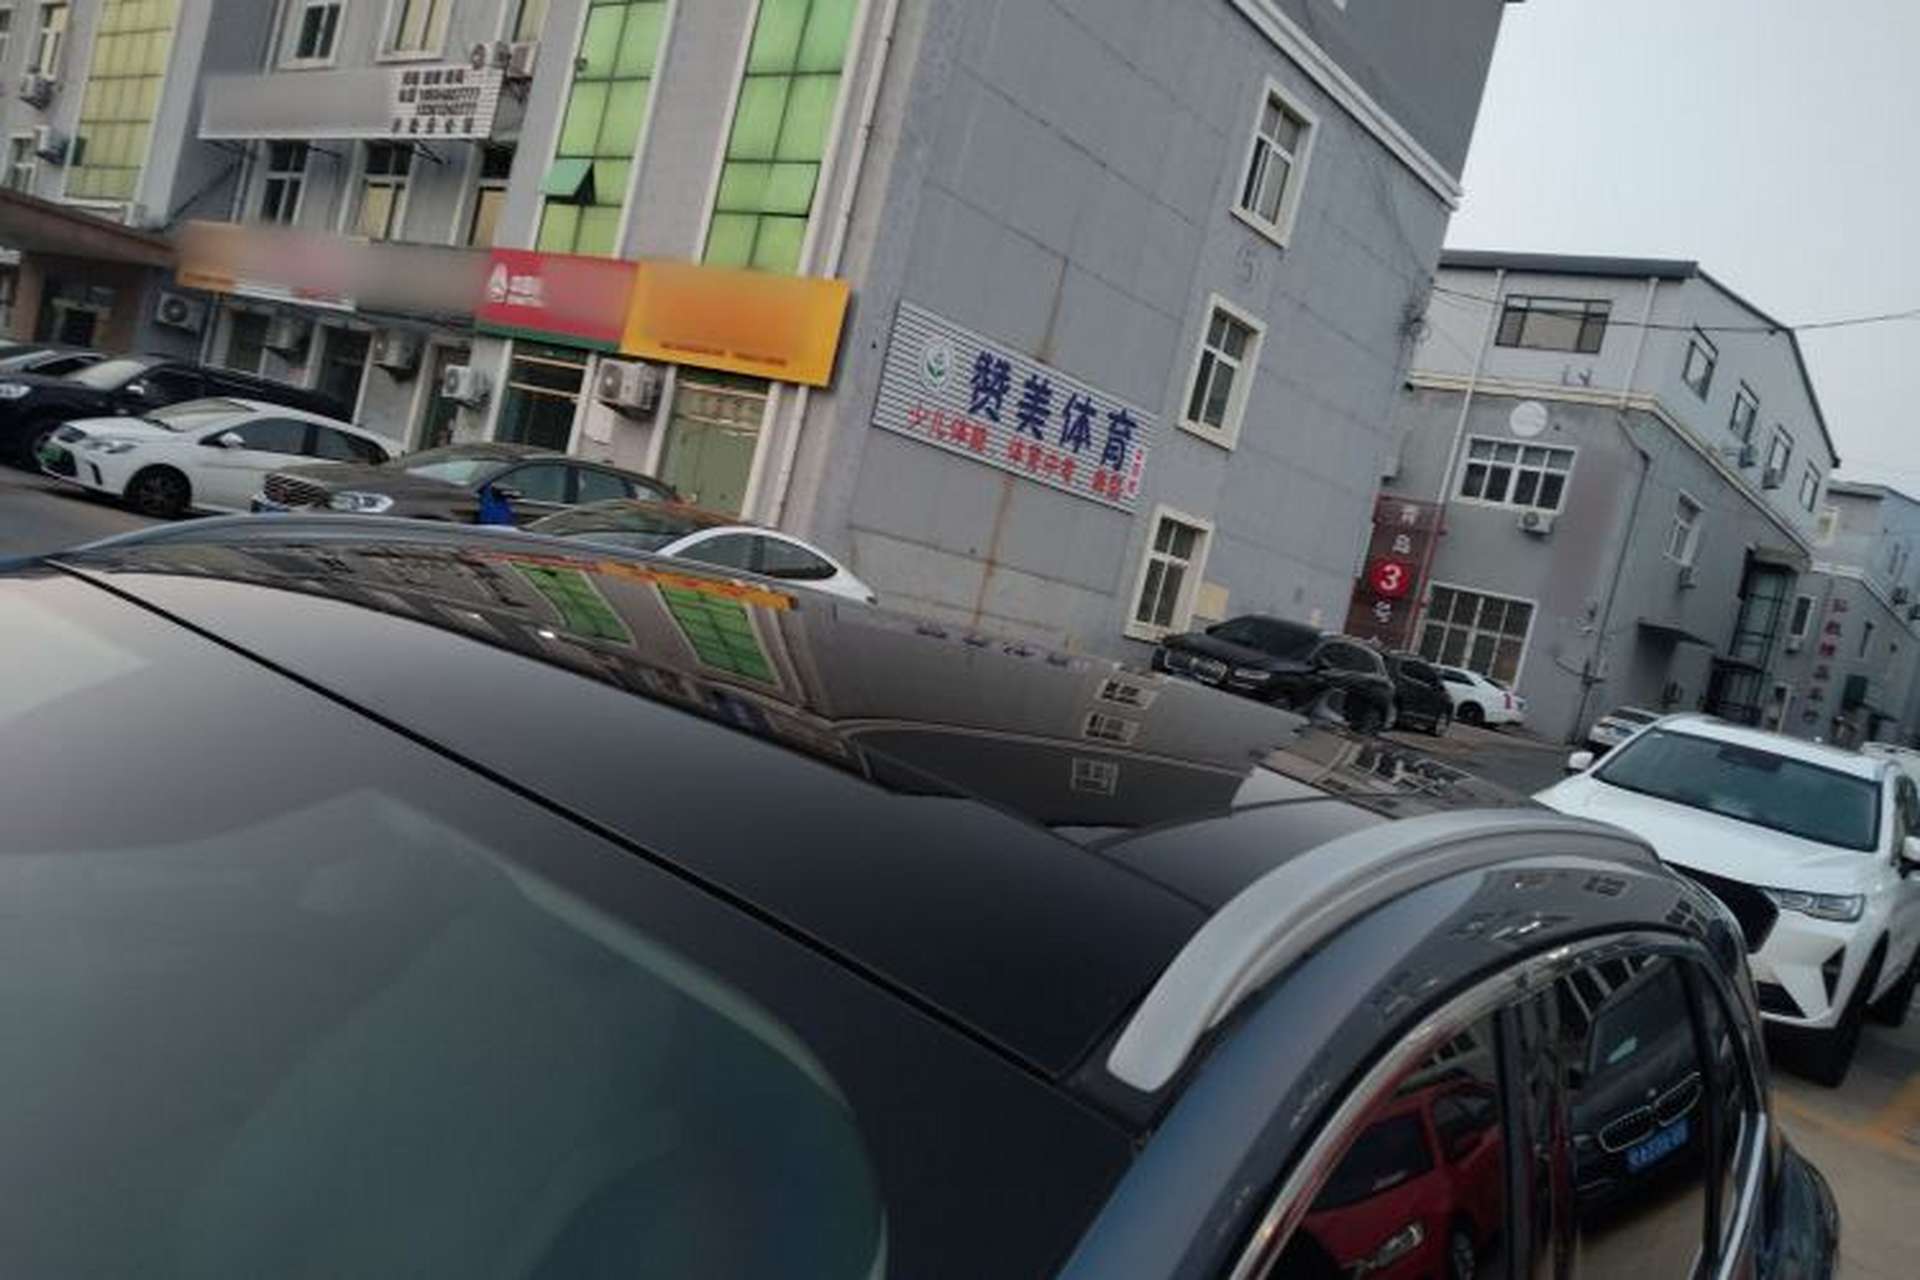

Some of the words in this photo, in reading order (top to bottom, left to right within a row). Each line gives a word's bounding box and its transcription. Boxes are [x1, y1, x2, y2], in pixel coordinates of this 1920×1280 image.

[967, 350, 1138, 472] 赞美体育
[1379, 563, 1403, 591] 3
